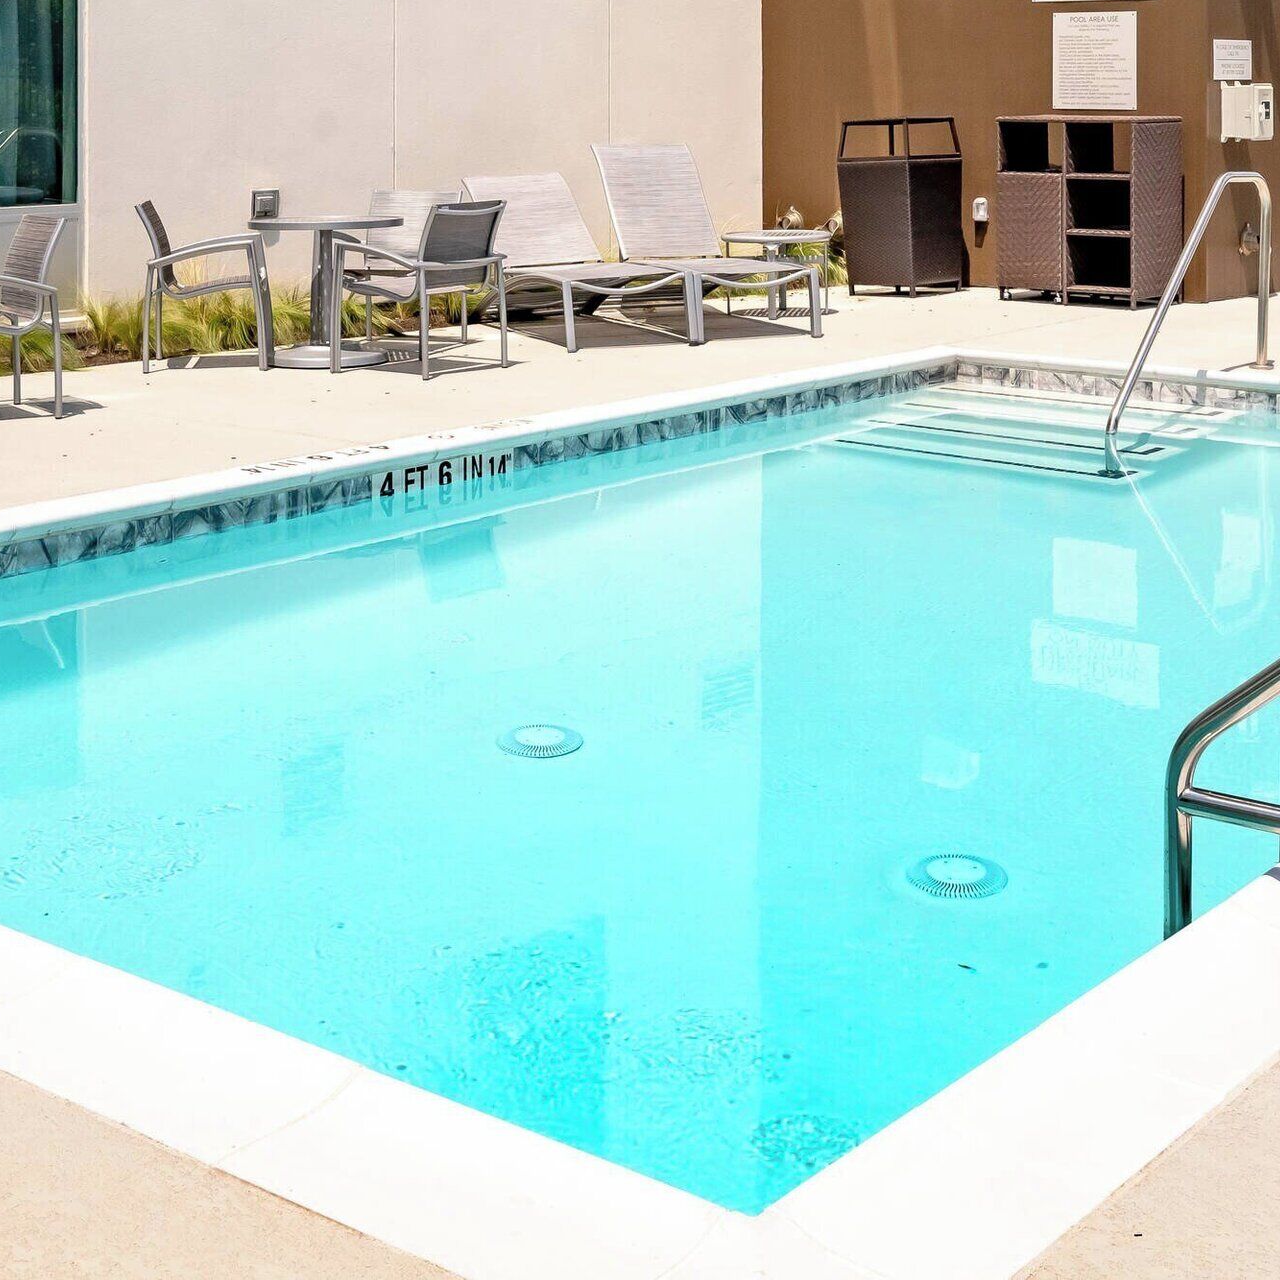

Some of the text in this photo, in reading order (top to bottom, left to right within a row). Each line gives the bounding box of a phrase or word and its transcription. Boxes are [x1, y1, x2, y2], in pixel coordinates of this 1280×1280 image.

[1106, 15, 1119, 23] USE
[380, 471, 395, 497] 4
[404, 464, 429, 494] FT
[438, 460, 453, 486] 6
[463, 453, 484, 481] IN
